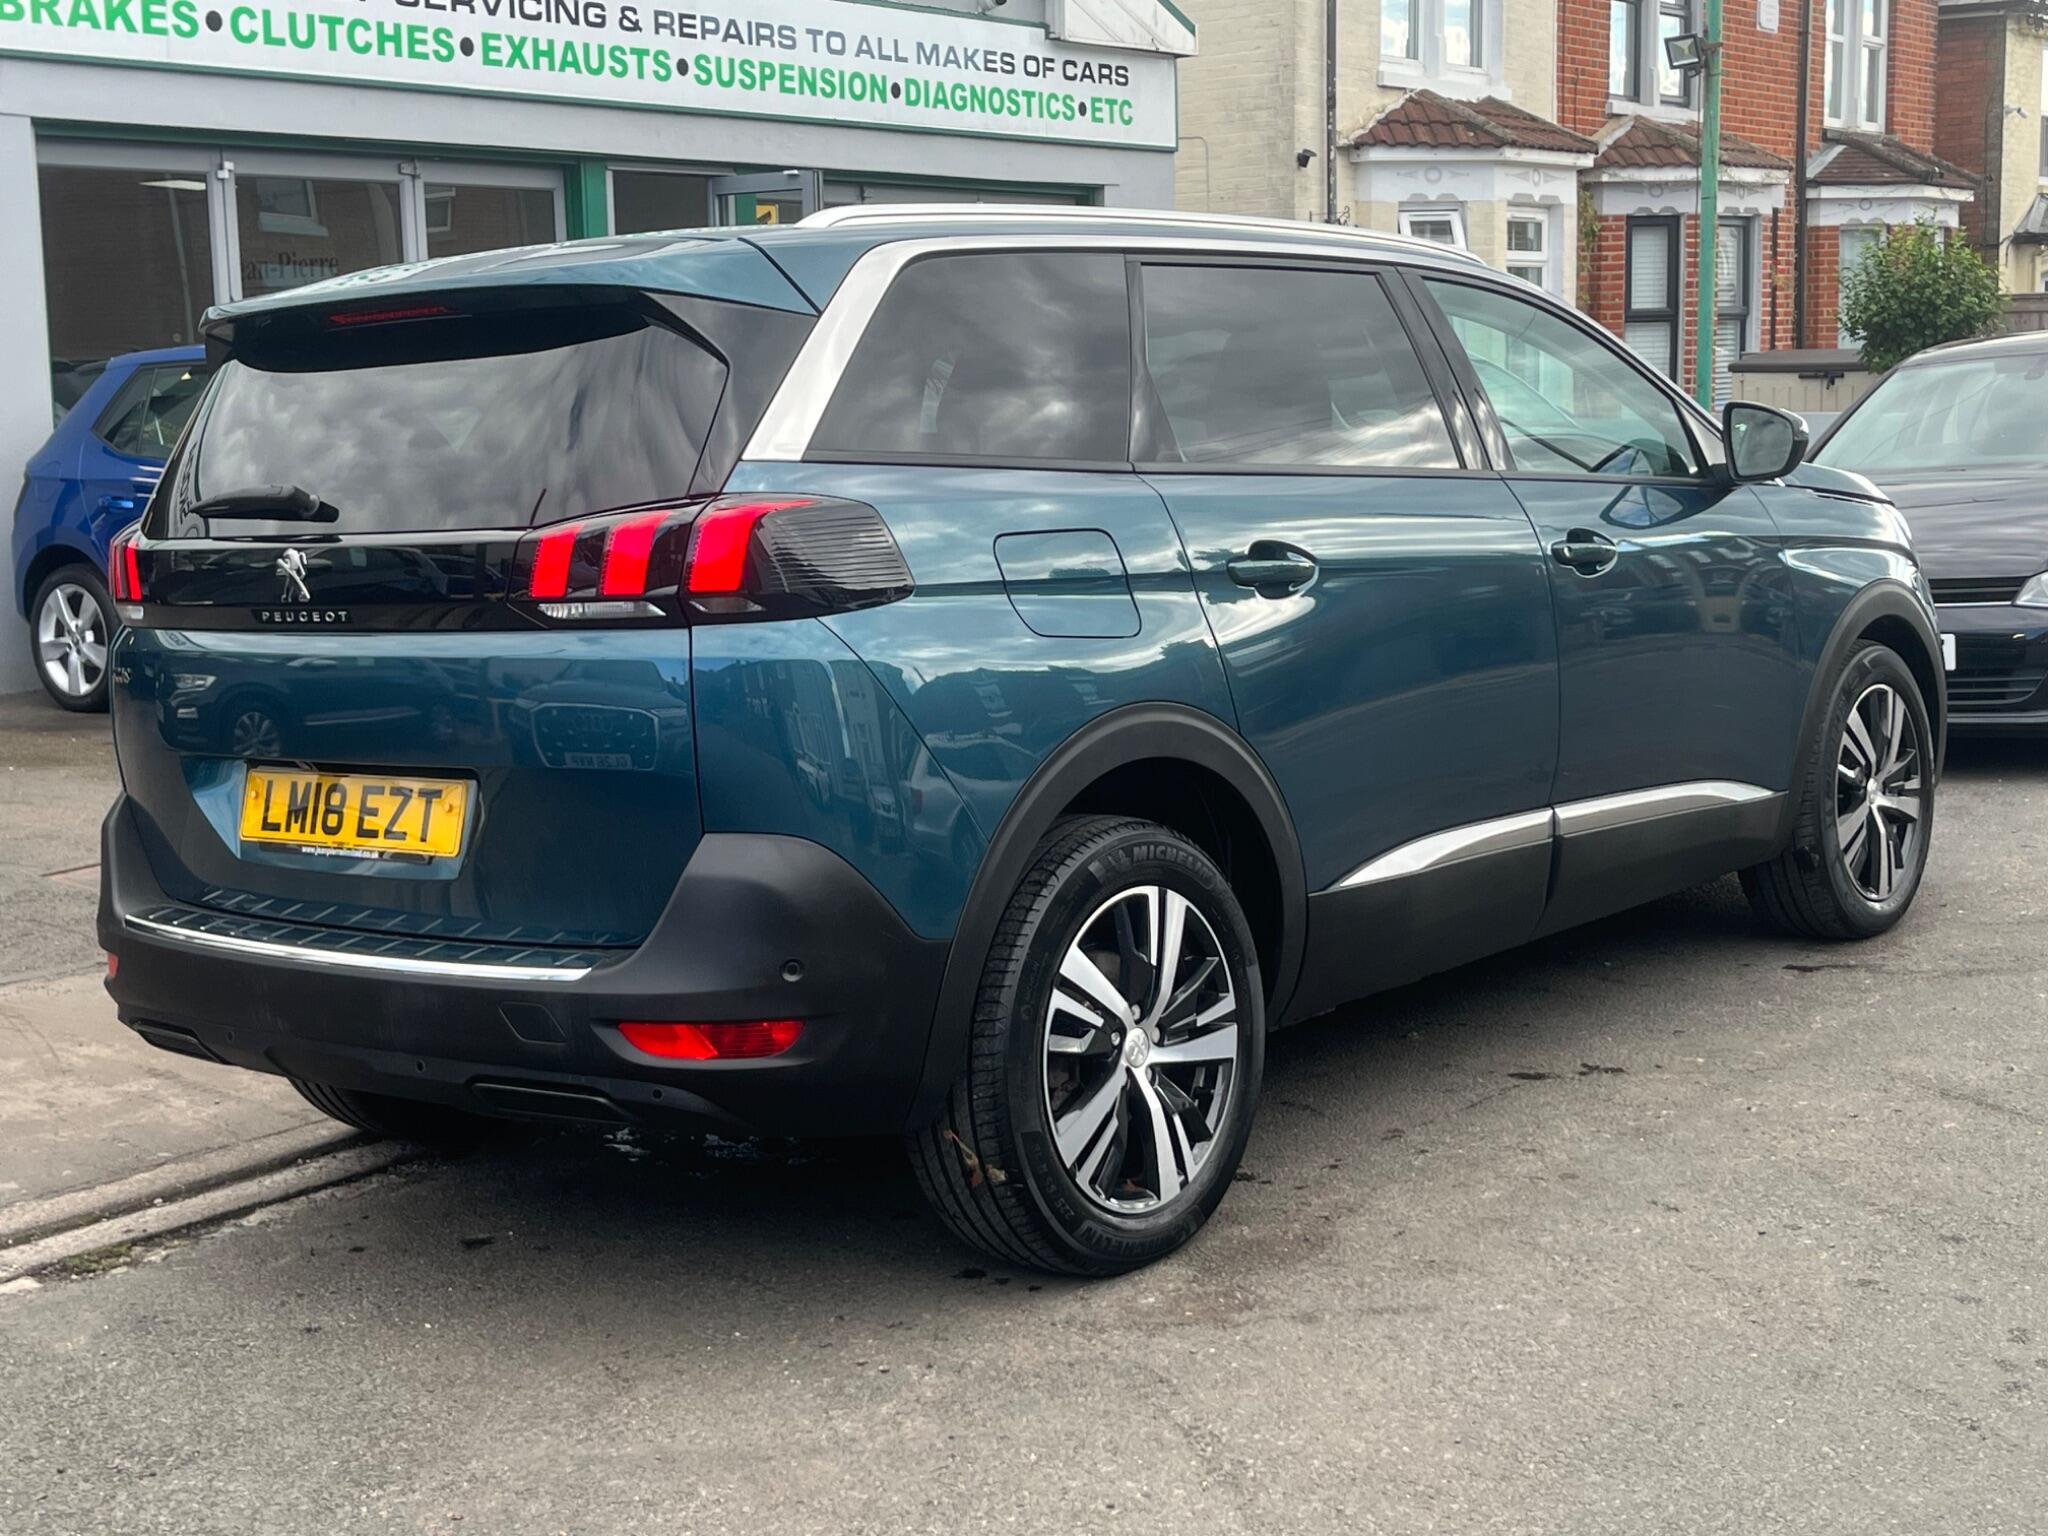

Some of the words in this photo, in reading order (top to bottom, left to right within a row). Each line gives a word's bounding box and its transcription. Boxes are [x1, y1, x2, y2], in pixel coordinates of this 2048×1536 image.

[230, 7, 455, 62] CLUTCHES
[481, 31, 672, 82] EXHAUSTS
[693, 53, 887, 104] SUSPENSION
[905, 78, 1076, 122] DIAGNOSTICS
[1090, 97, 1133, 126] ETC
[618, 6, 642, 33] &
[654, 10, 797, 50] REPAIRS
[805, 28, 846, 56] TO
[854, 35, 908, 63] ALL
[916, 42, 1015, 75] MAKES
[1023, 54, 1055, 79] OF
[1062, 59, 1129, 87] CARS
[261, 610, 348, 623] PEUGEOT
[356, 784, 443, 843] EZT
